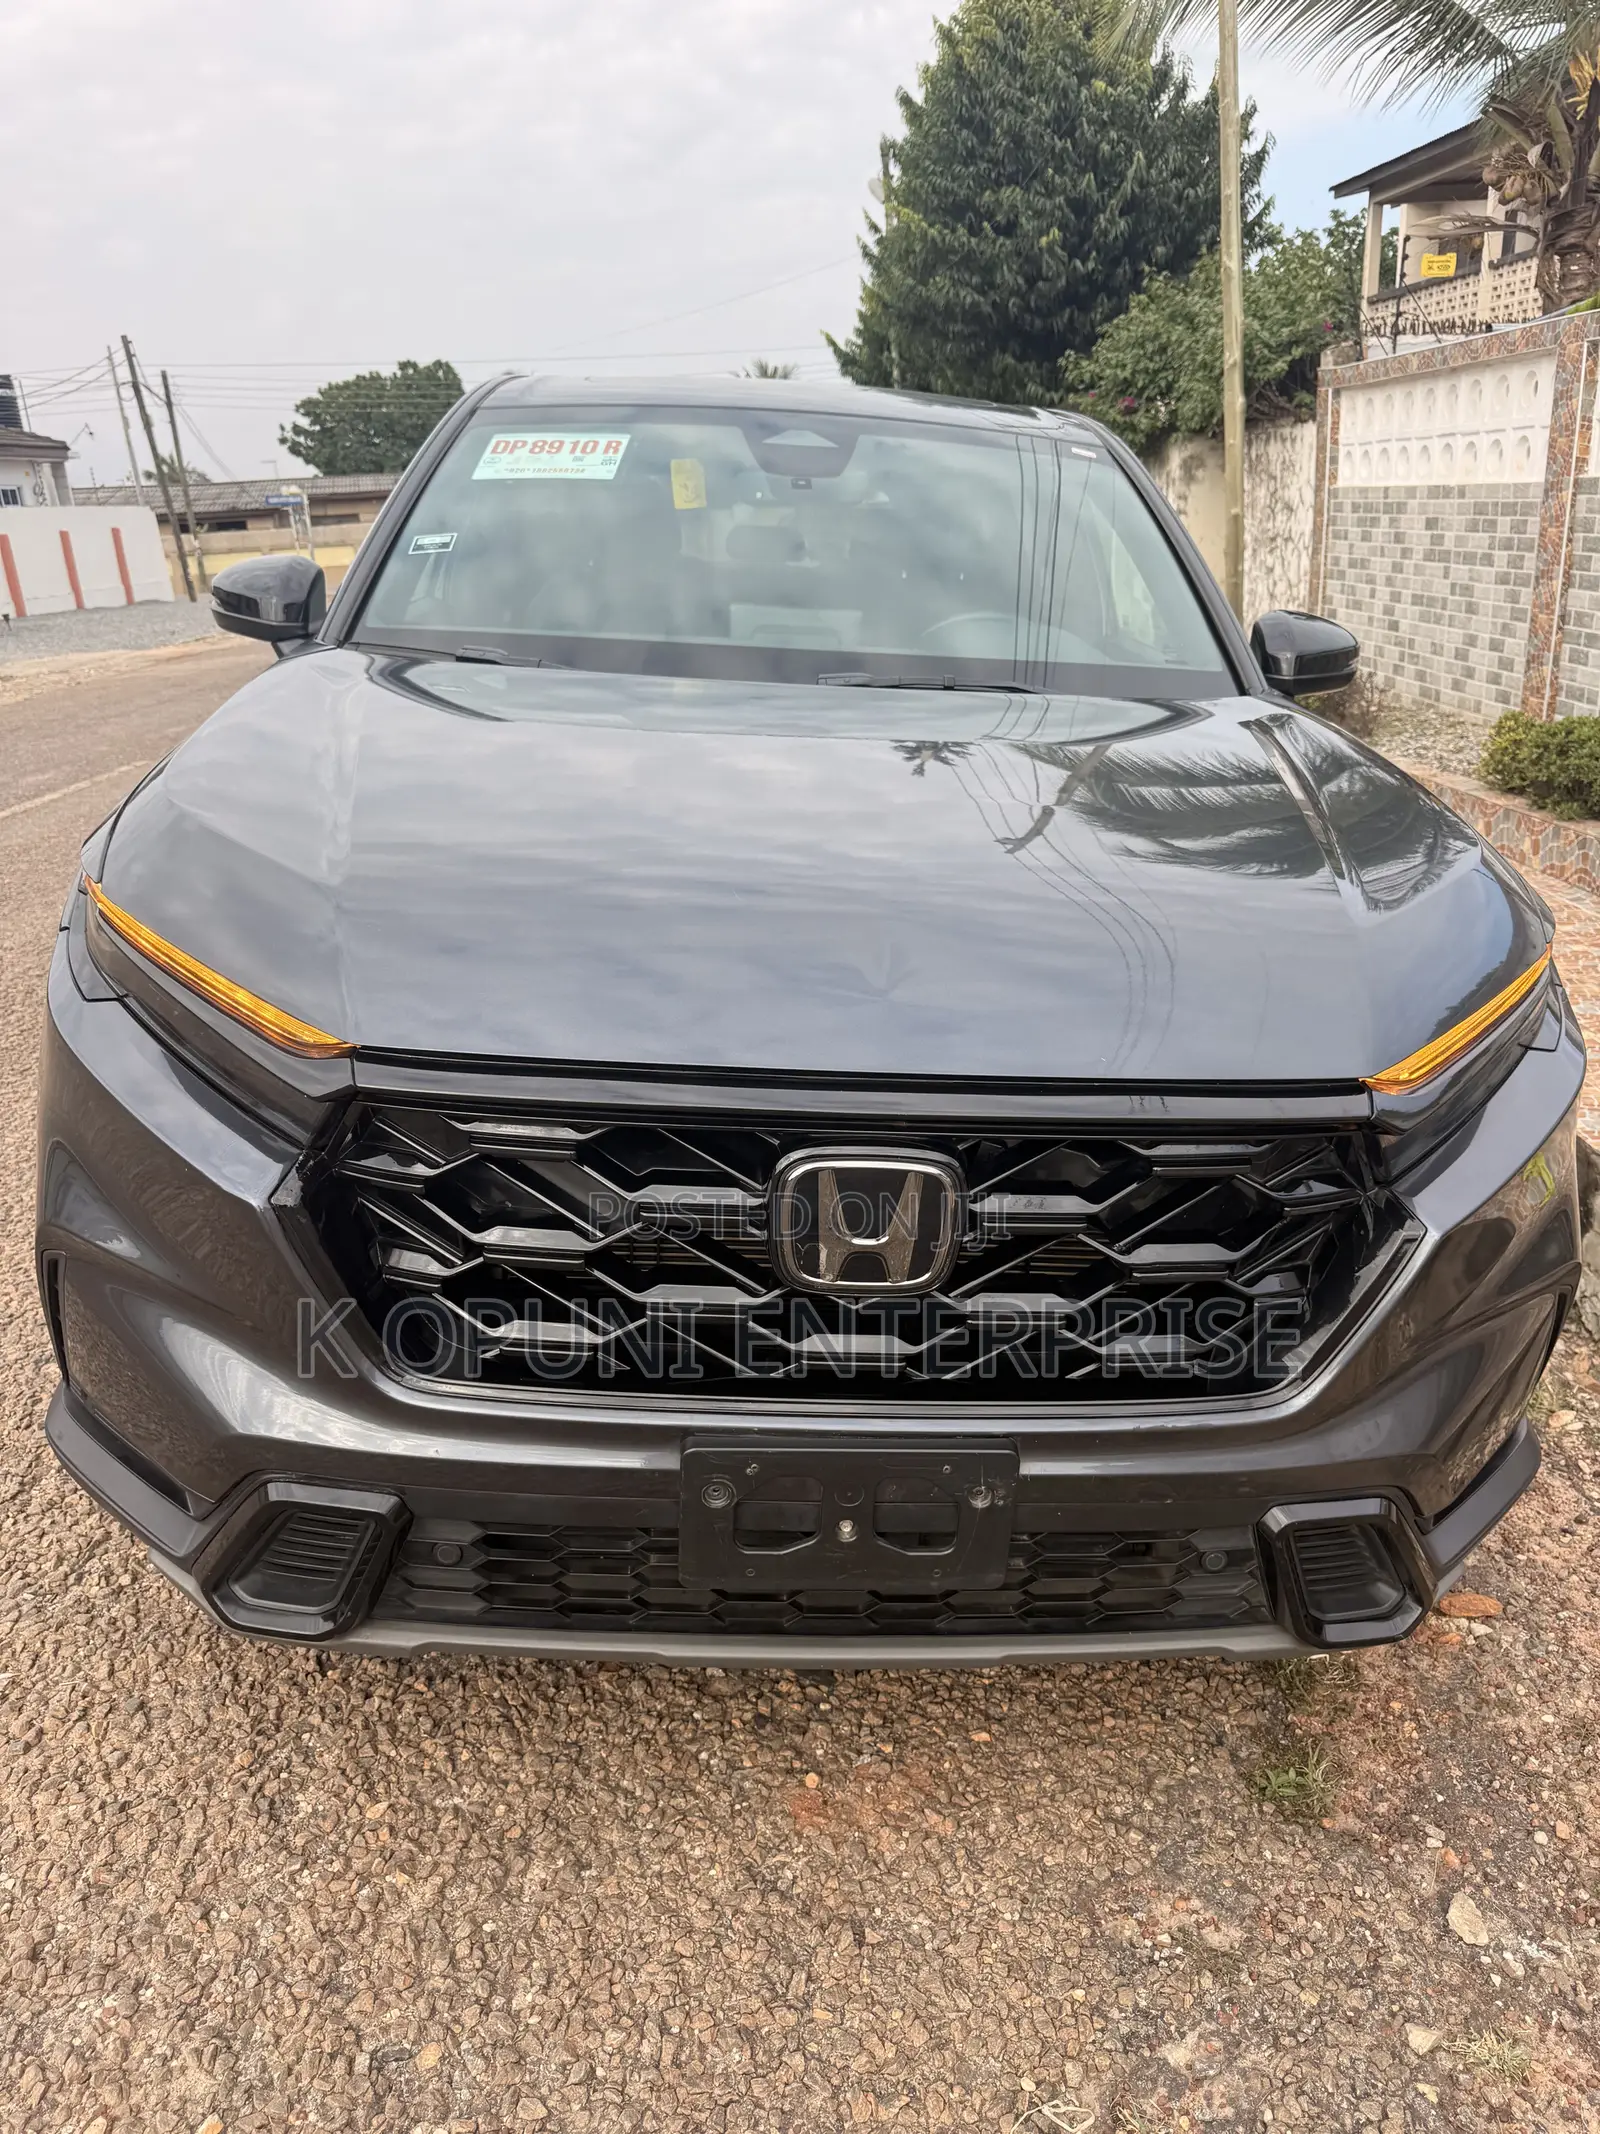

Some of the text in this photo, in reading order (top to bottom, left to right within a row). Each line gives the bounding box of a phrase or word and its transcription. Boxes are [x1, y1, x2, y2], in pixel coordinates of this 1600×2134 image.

[490, 439, 622, 455] DP 8910 R
